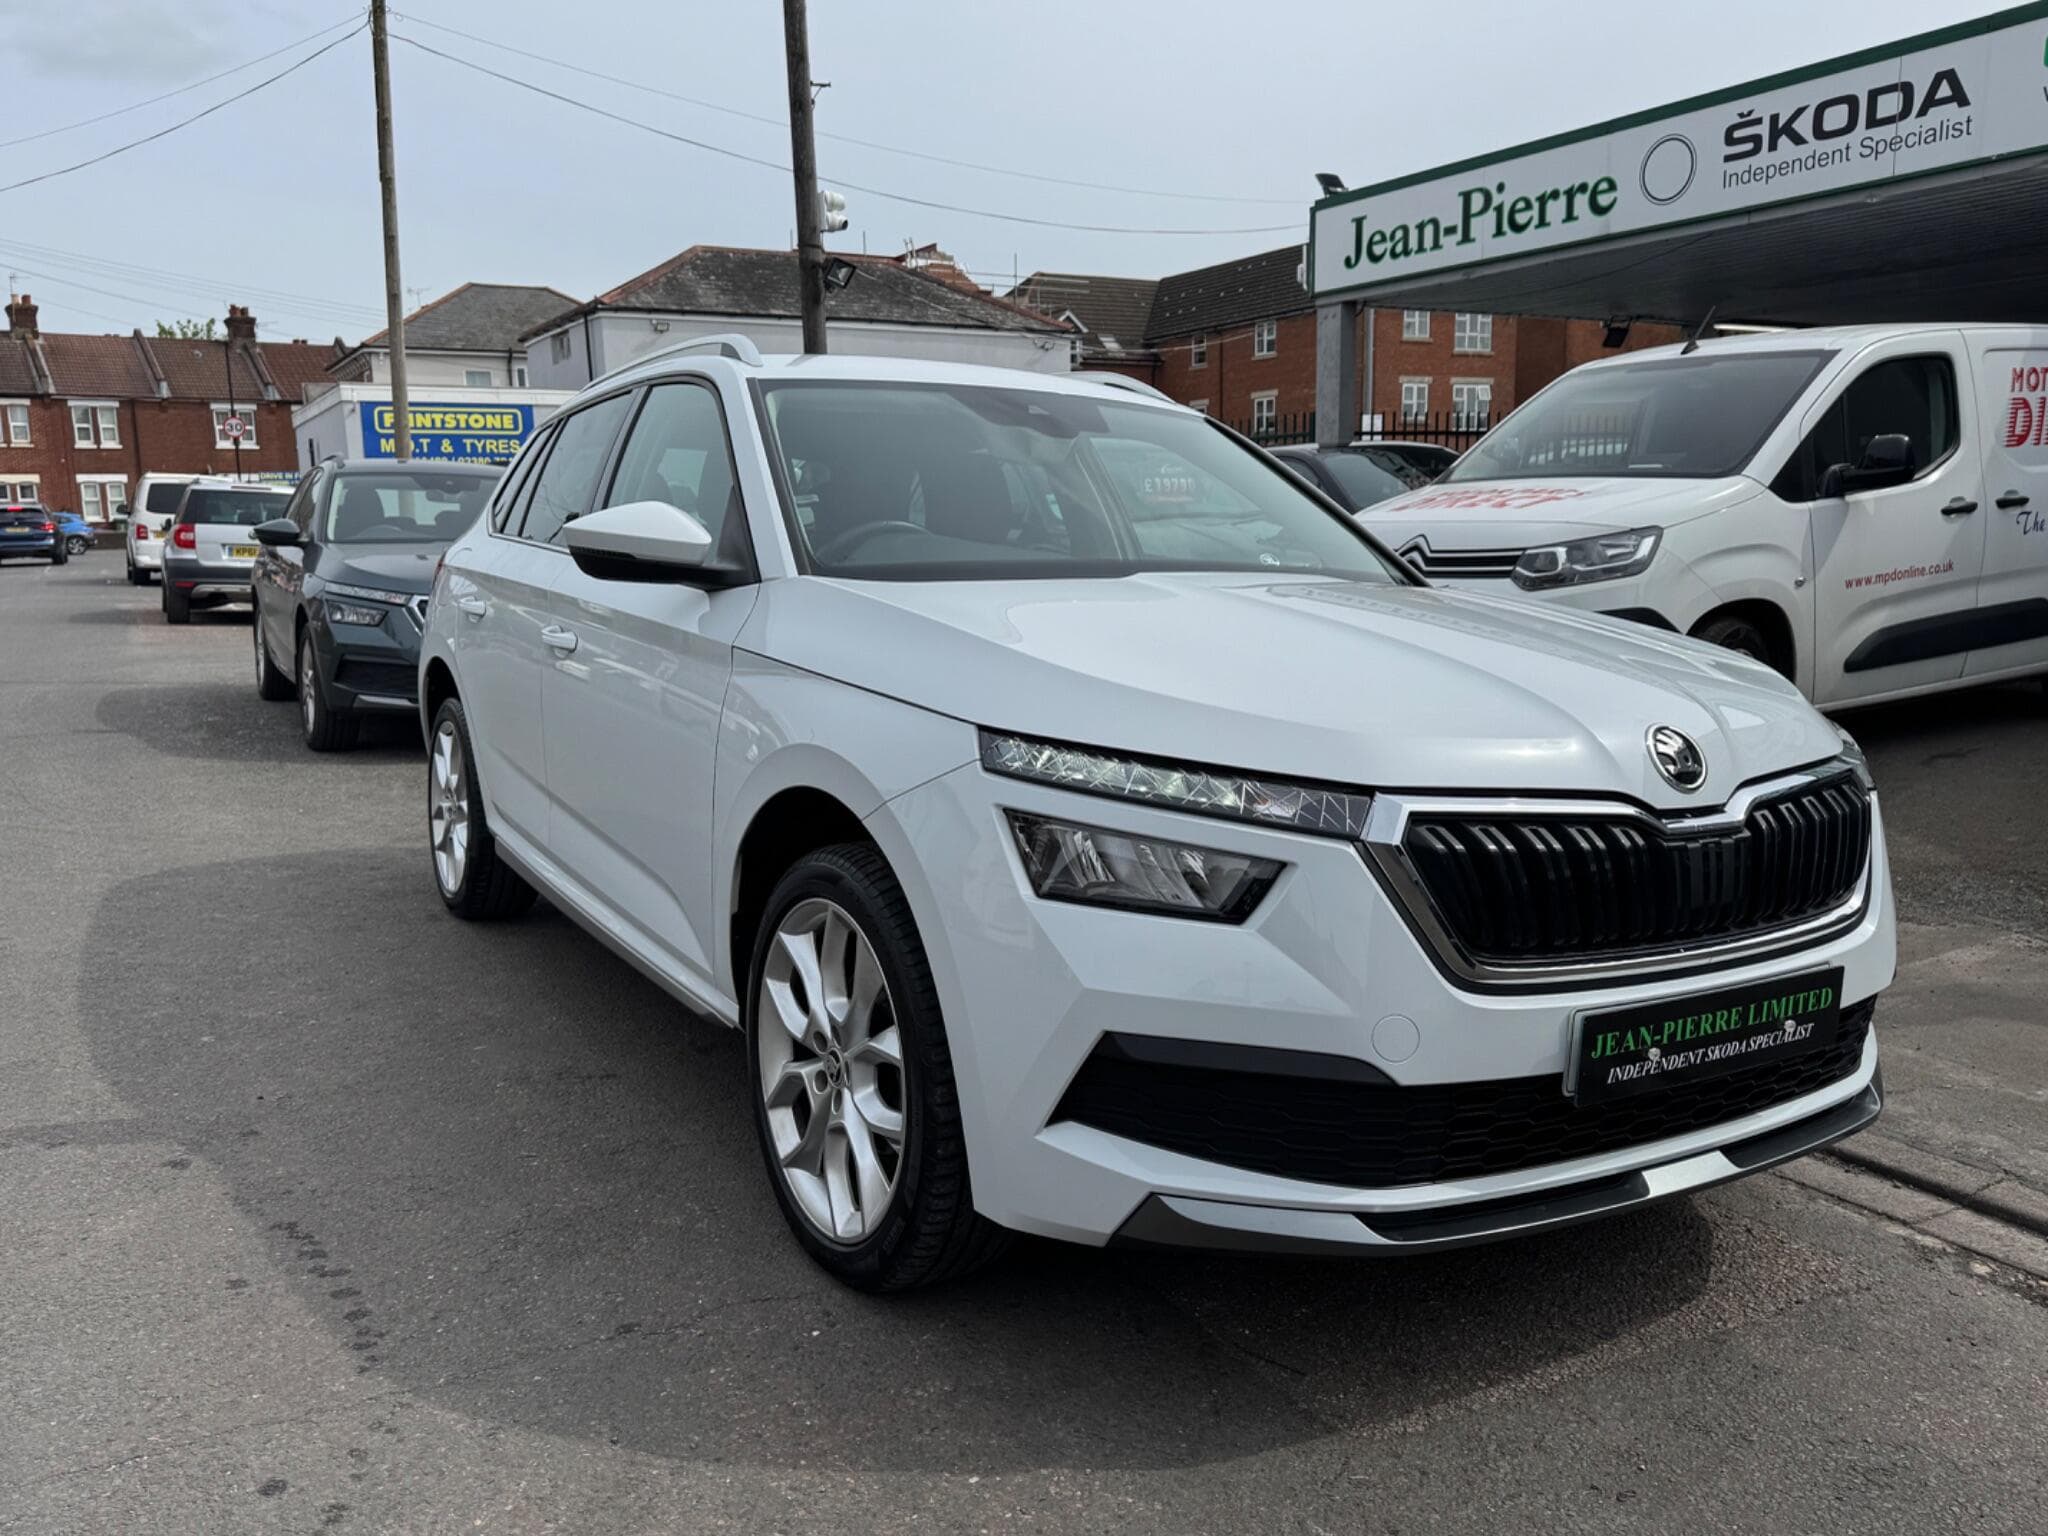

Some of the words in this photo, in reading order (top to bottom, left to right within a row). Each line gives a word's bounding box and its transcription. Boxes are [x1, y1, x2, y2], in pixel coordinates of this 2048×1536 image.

[1721, 67, 1971, 164] ŠKODA
[1721, 142, 1852, 190] Independent
[1858, 115, 1974, 161] Specialist
[1344, 174, 1619, 270] Jean-Pierre
[226, 422, 243, 433] 30
[383, 413, 514, 429] FINTSTONE
[440, 438, 454, 453] &
[463, 439, 520, 454] TYRES
[2004, 396, 2048, 448] DI
[2016, 510, 2046, 536] The
[1844, 559, 1954, 590] www.mpdonline.co.uk
[1591, 1007, 1743, 1060] JEAN-PIERRE
[1747, 986, 1834, 1026] LIMITED
[1607, 1047, 1706, 1085] INDEPENDENT
[1704, 1040, 1748, 1062] SKODA
[1747, 1022, 1815, 1052] SPECIALIST
